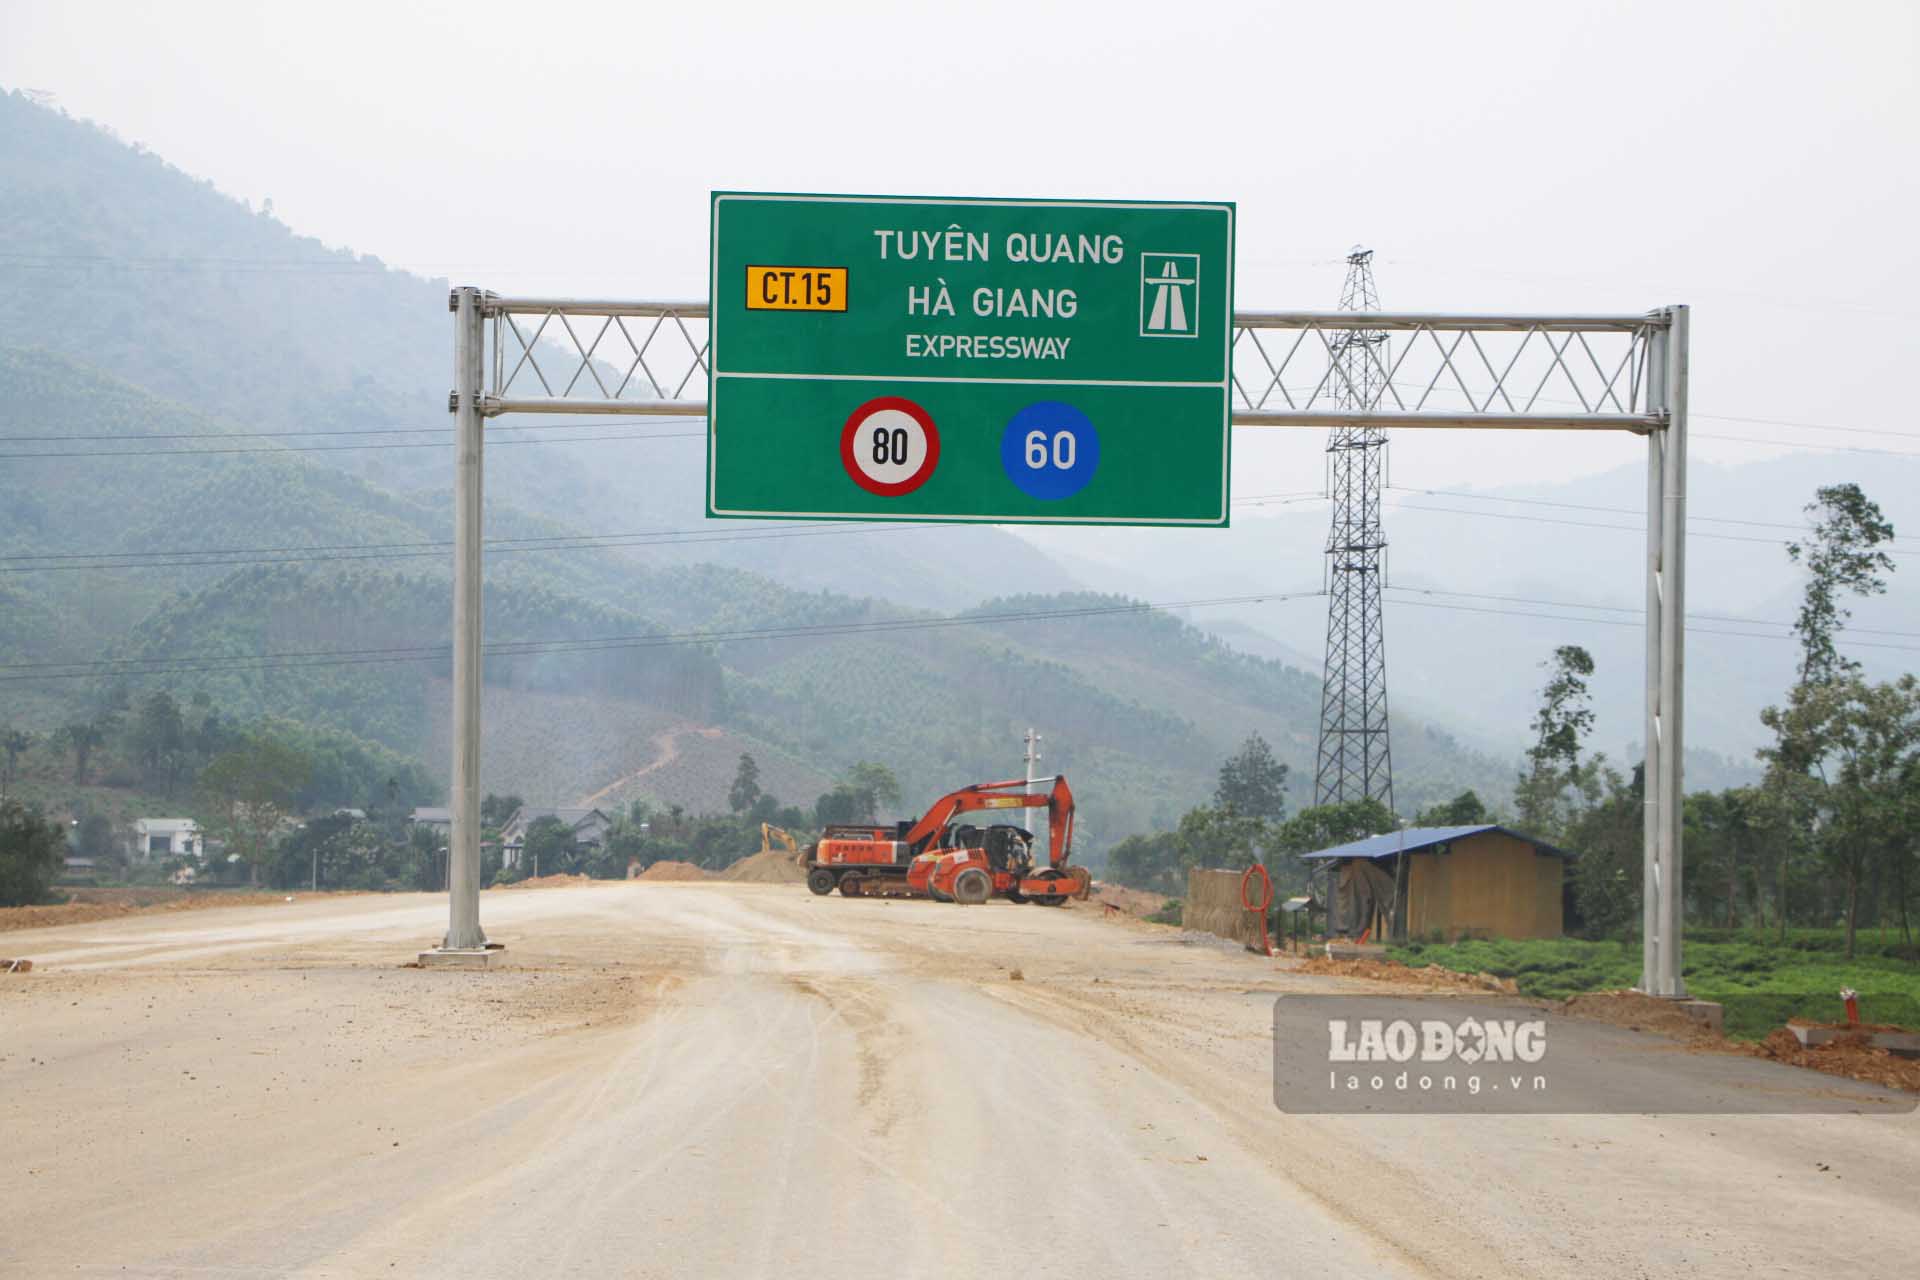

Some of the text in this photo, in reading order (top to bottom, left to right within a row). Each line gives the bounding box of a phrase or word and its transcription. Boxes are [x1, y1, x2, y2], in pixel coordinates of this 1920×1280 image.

[874, 224, 1124, 264] TUYÊN QUANG
[762, 271, 831, 305] CT.15
[907, 278, 1078, 319] HÀ GIANG
[905, 335, 1071, 360] EXPRESSWAY
[872, 428, 908, 466] 80
[1025, 431, 1076, 470] 60
